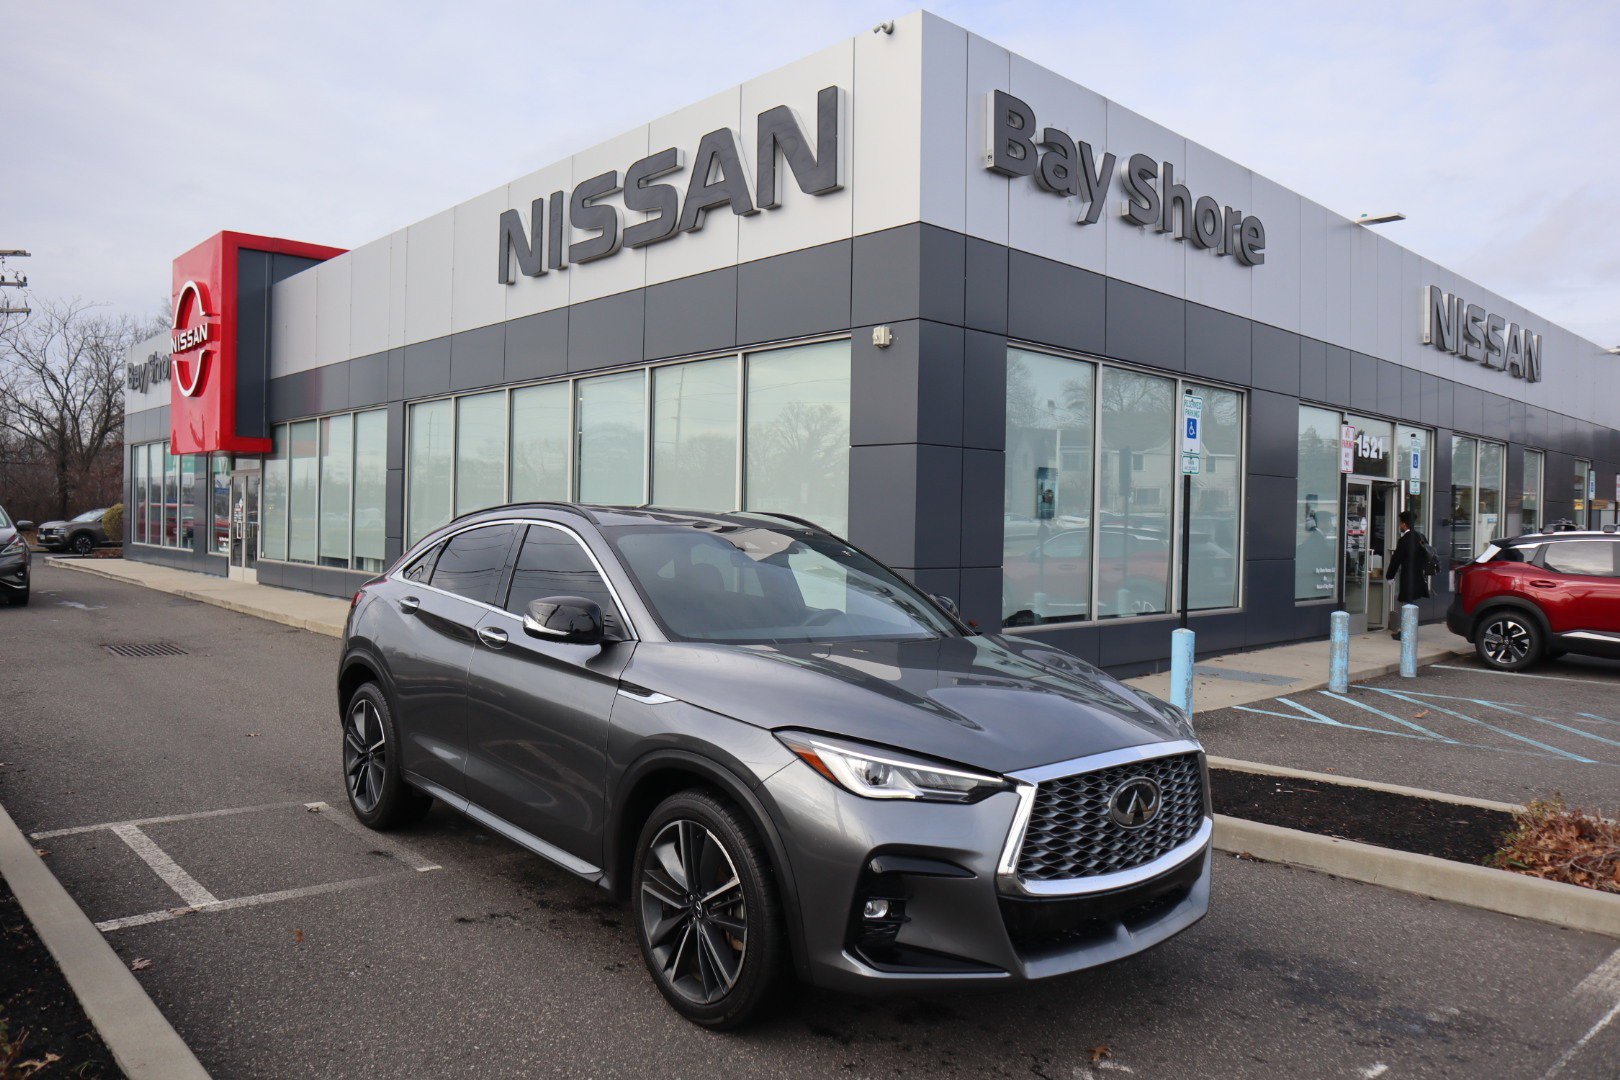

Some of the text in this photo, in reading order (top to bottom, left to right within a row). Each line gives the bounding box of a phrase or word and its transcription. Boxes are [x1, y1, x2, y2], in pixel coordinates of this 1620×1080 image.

[498, 85, 845, 285] NISSAN
[986, 89, 1266, 266] Bay Shore
[170, 323, 208, 353] NISSAN
[1424, 285, 1542, 382] NISSAN
[127, 362, 148, 394] Bay
[1357, 434, 1383, 460] 1521
